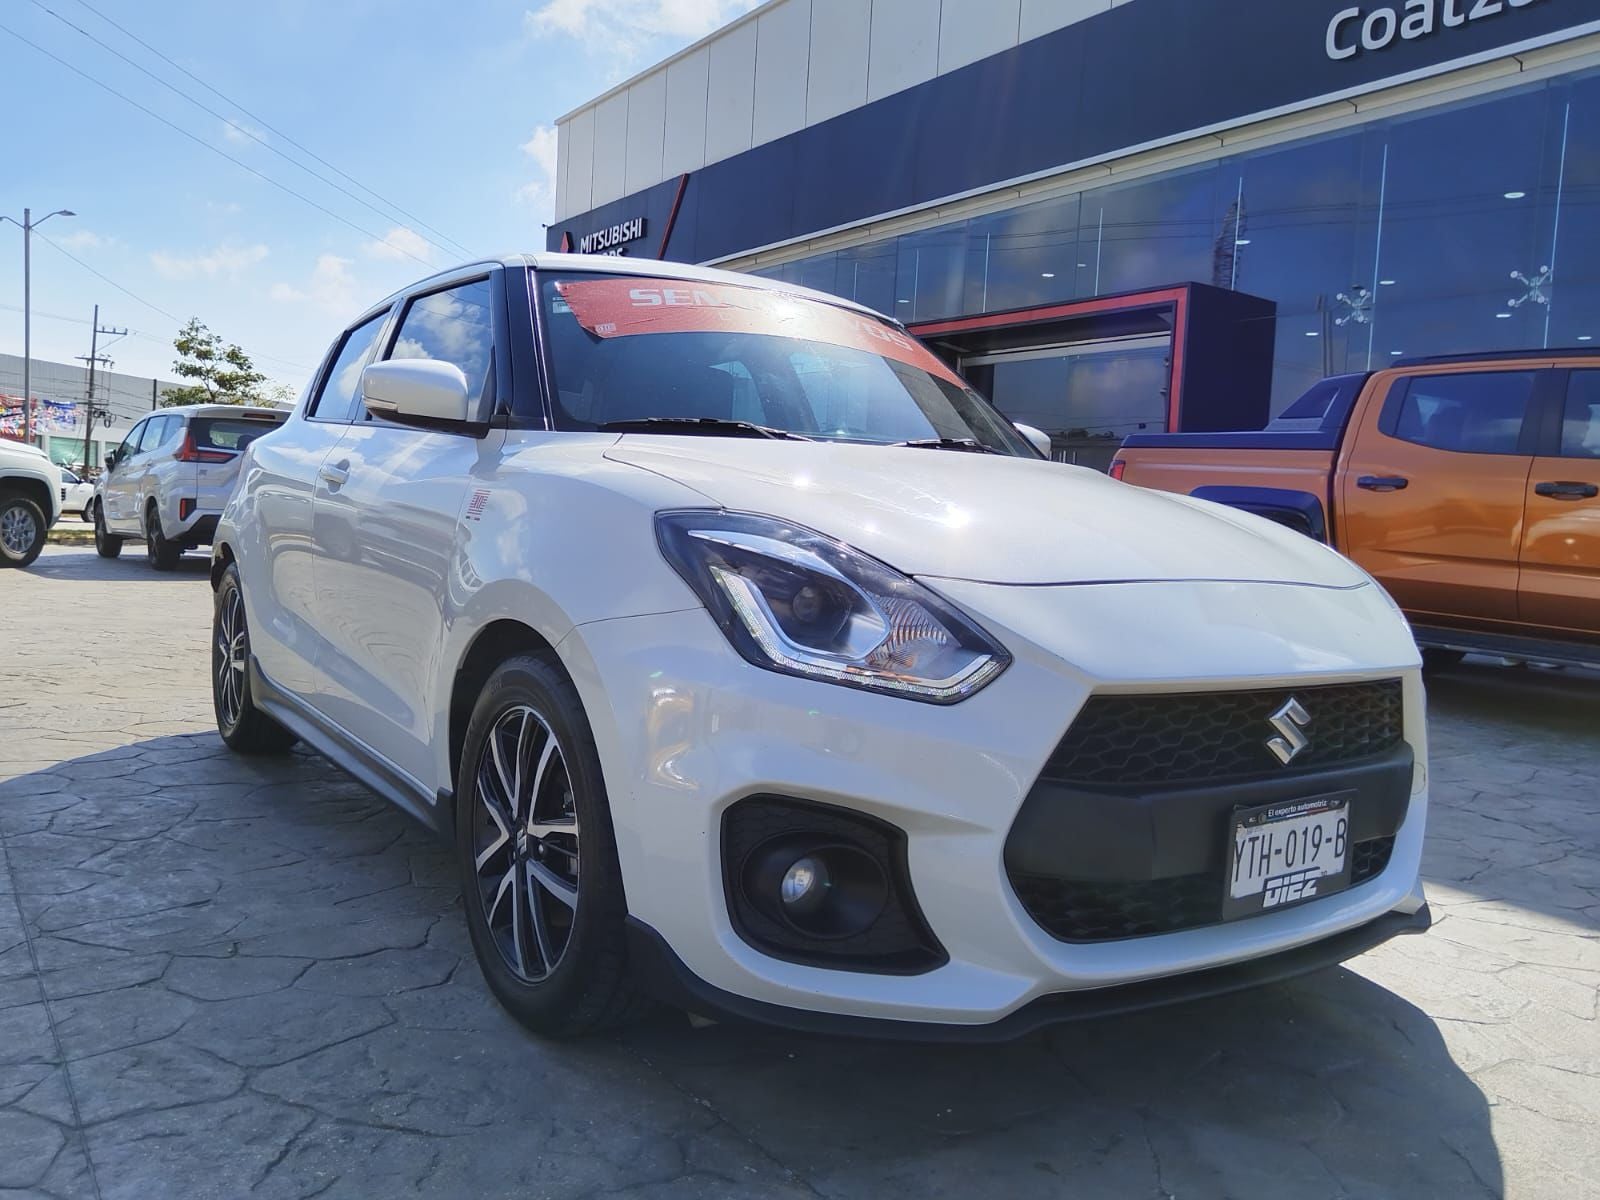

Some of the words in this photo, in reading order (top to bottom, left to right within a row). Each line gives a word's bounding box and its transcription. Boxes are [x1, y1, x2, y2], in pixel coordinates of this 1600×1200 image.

[580, 217, 643, 254] MITSUBISHI
[1274, 804, 1297, 816] experto
[1297, 800, 1328, 811] automotriz
[1234, 818, 1347, 882] YTH-019-B
